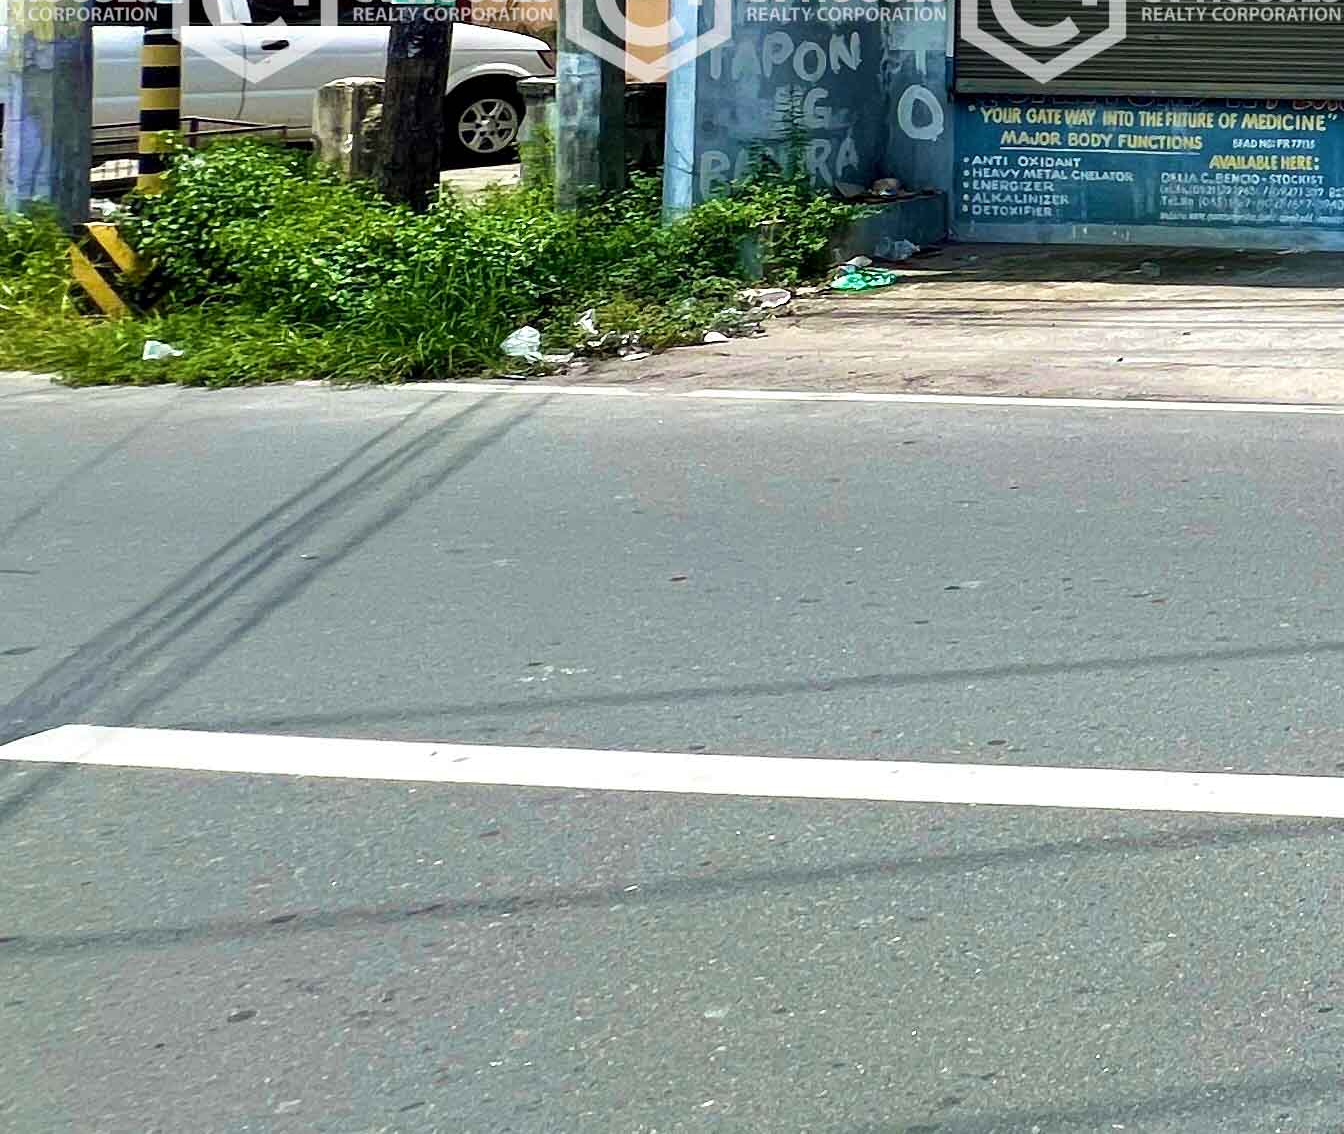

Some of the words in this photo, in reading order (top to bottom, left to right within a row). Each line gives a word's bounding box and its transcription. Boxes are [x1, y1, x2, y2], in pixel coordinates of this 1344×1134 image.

[702, 31, 863, 83] TAPON
[1102, 110, 1134, 127] INTO
[1138, 111, 1165, 127] THE
[1166, 112, 1214, 128] FUTURE
[1218, 113, 1237, 129] OF
[1000, 130, 1061, 146] MAJOR
[1067, 132, 1113, 147] BODY
[1117, 134, 1203, 151] FUNCTIONS
[972, 155, 1008, 166] ANTI
[1017, 156, 1081, 167] OXIDANT
[1209, 154, 1279, 170] AVAILABLE
[1281, 155, 1320, 170] HERE:
[972, 168, 1020, 178] HEAVY
[1023, 169, 1067, 180] METAL
[1071, 170, 1134, 182] CHELATOR
[1271, 174, 1324, 185] STOCKIST
[972, 180, 1055, 191] ENERGIZER
[972, 193, 1070, 205] ALKALINIZER
[971, 205, 1053, 217] DETOXIFIER
